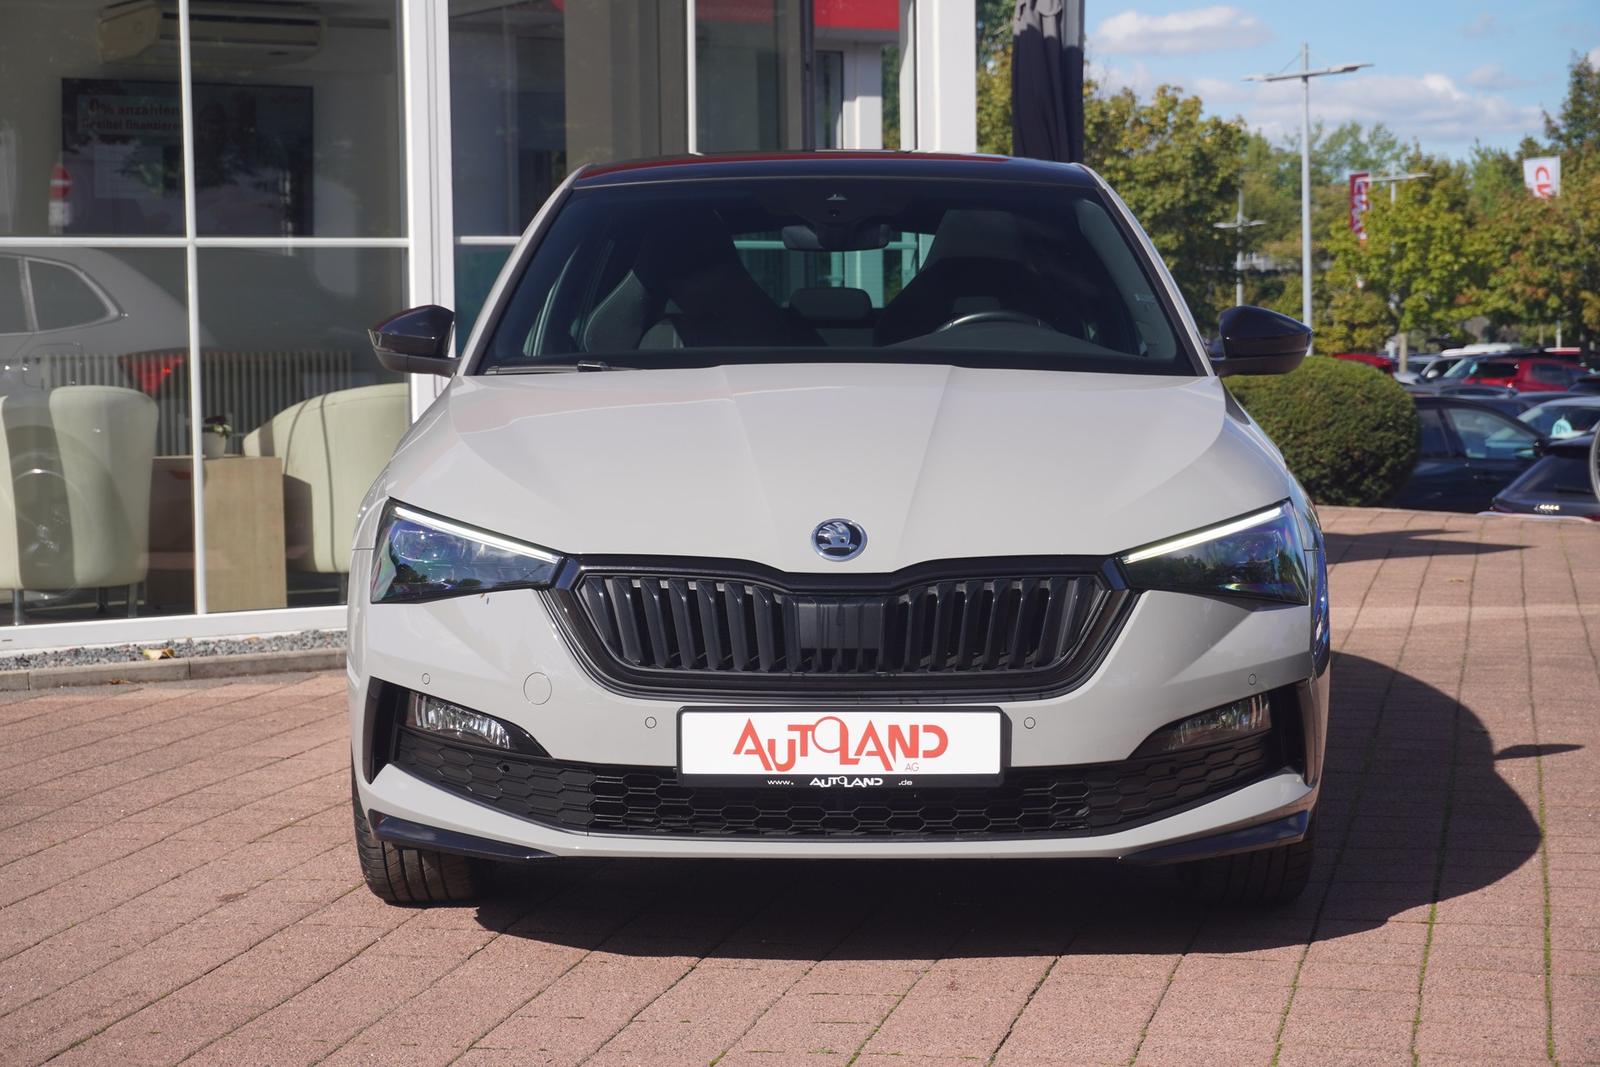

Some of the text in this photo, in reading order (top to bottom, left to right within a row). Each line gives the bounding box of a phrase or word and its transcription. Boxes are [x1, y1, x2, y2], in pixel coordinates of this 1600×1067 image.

[733, 716, 949, 772] AUTOLAND
[904, 762, 920, 772] AG
[767, 776, 914, 788] www. AUTOLAND .de
